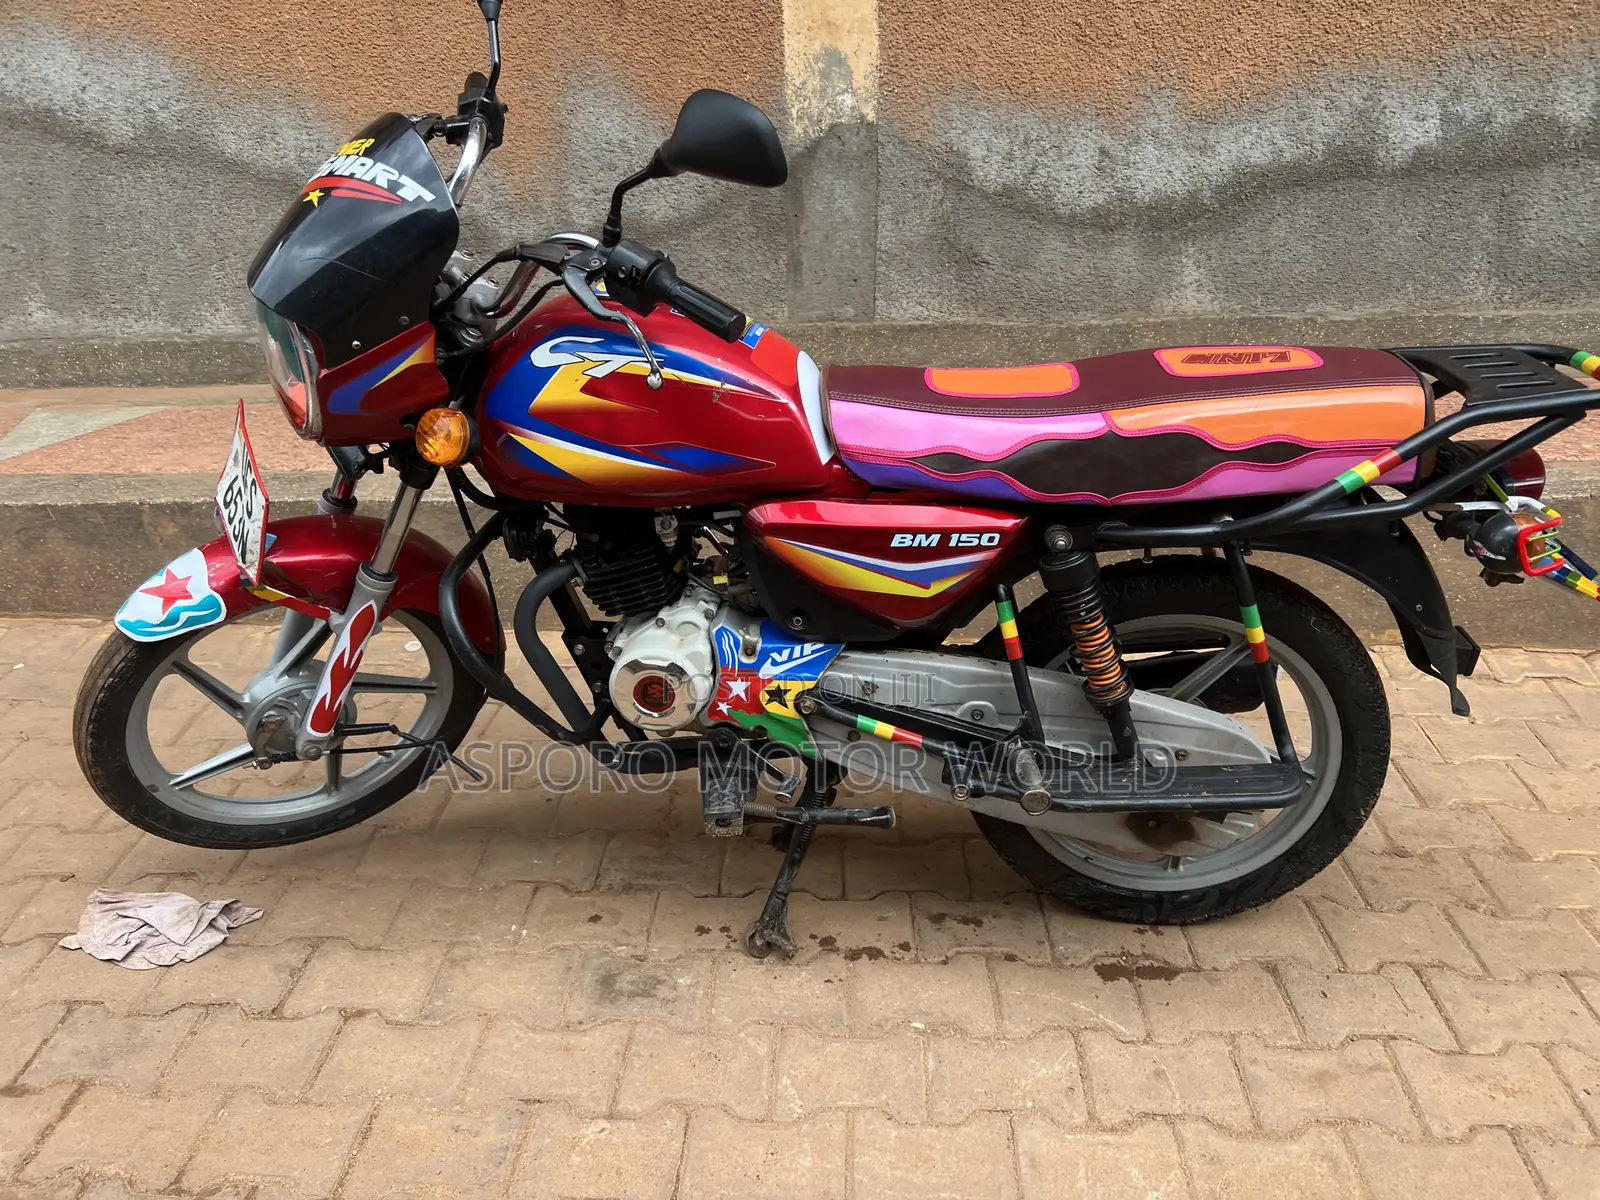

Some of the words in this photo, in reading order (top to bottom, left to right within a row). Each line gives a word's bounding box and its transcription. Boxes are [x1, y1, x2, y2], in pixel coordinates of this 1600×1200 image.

[889, 532, 942, 548] BM
[948, 532, 1001, 547] 150
[769, 641, 825, 663] VIP
